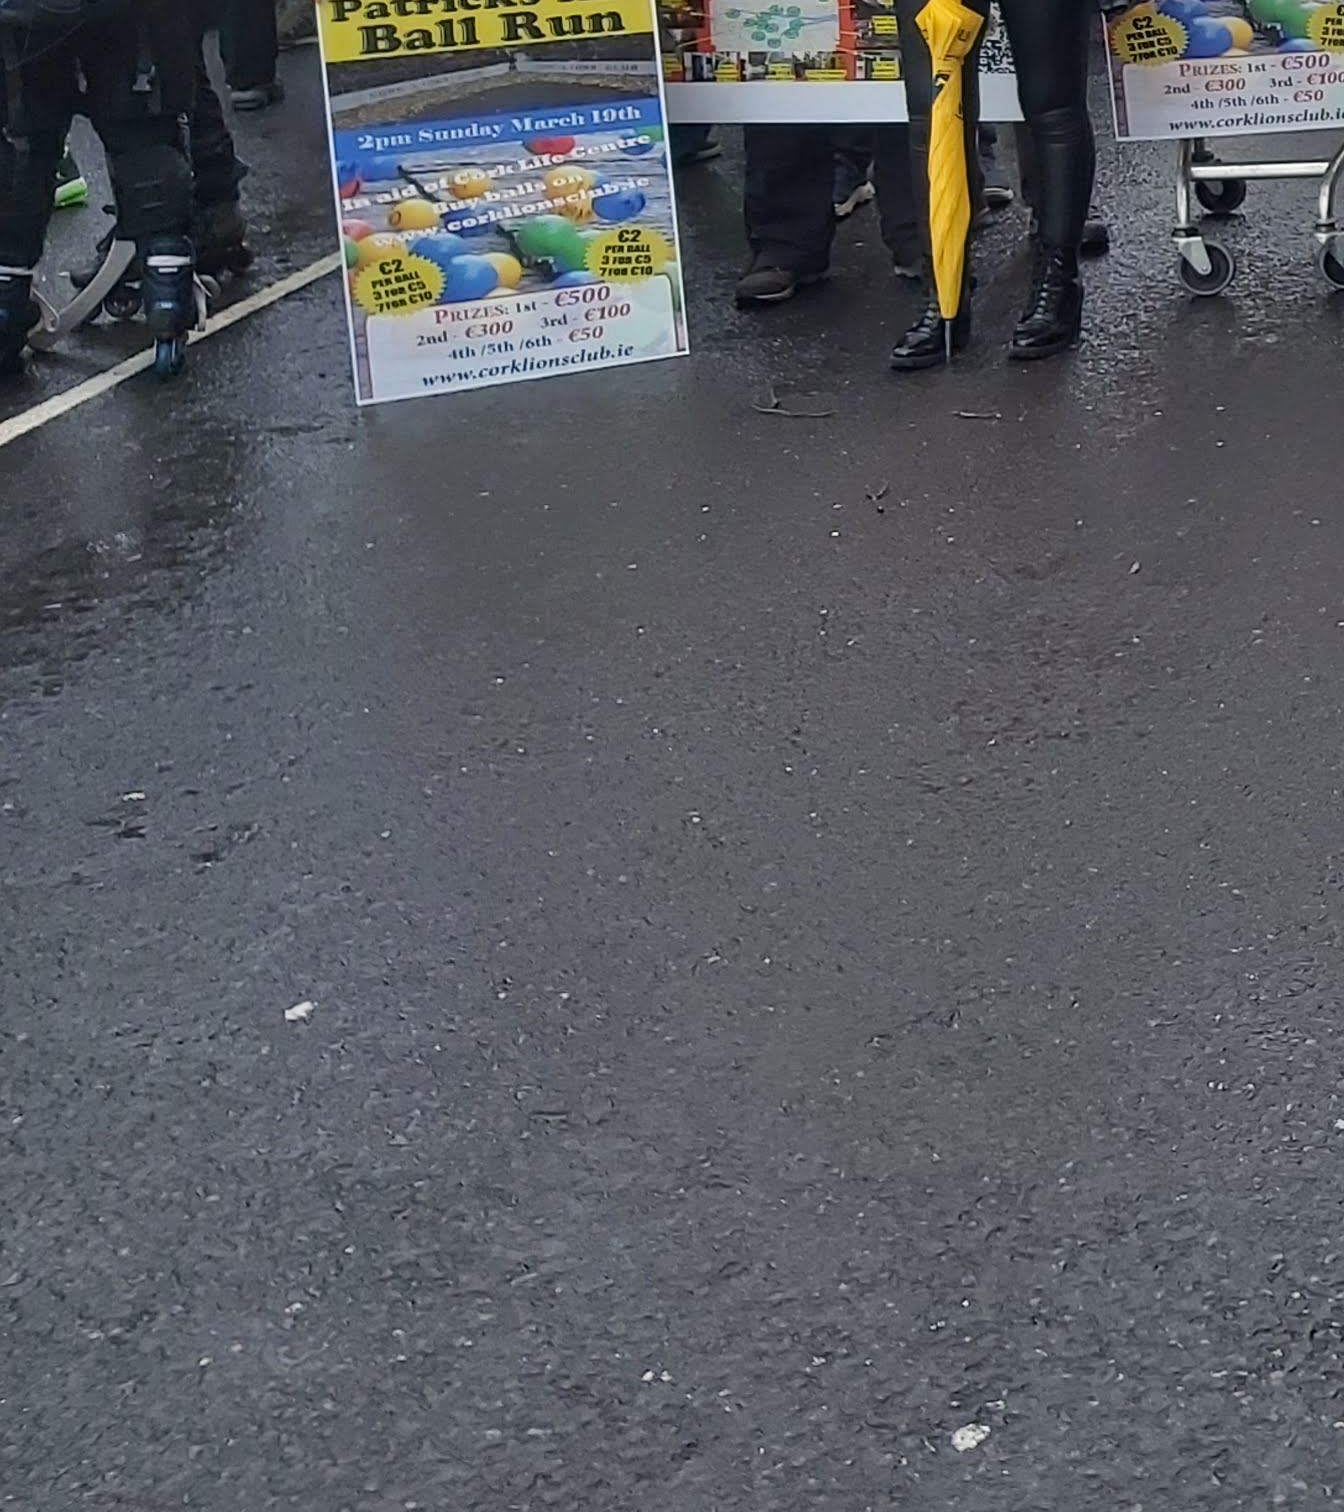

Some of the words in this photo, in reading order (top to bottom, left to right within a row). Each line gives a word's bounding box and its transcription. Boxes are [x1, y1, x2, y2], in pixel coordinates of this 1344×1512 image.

[358, 16, 480, 55] Ball
[500, 8, 624, 42] Run
[419, 121, 504, 142] Sunday
[511, 111, 584, 133] March
[422, 343, 634, 387] www.corklionsclub.ie
